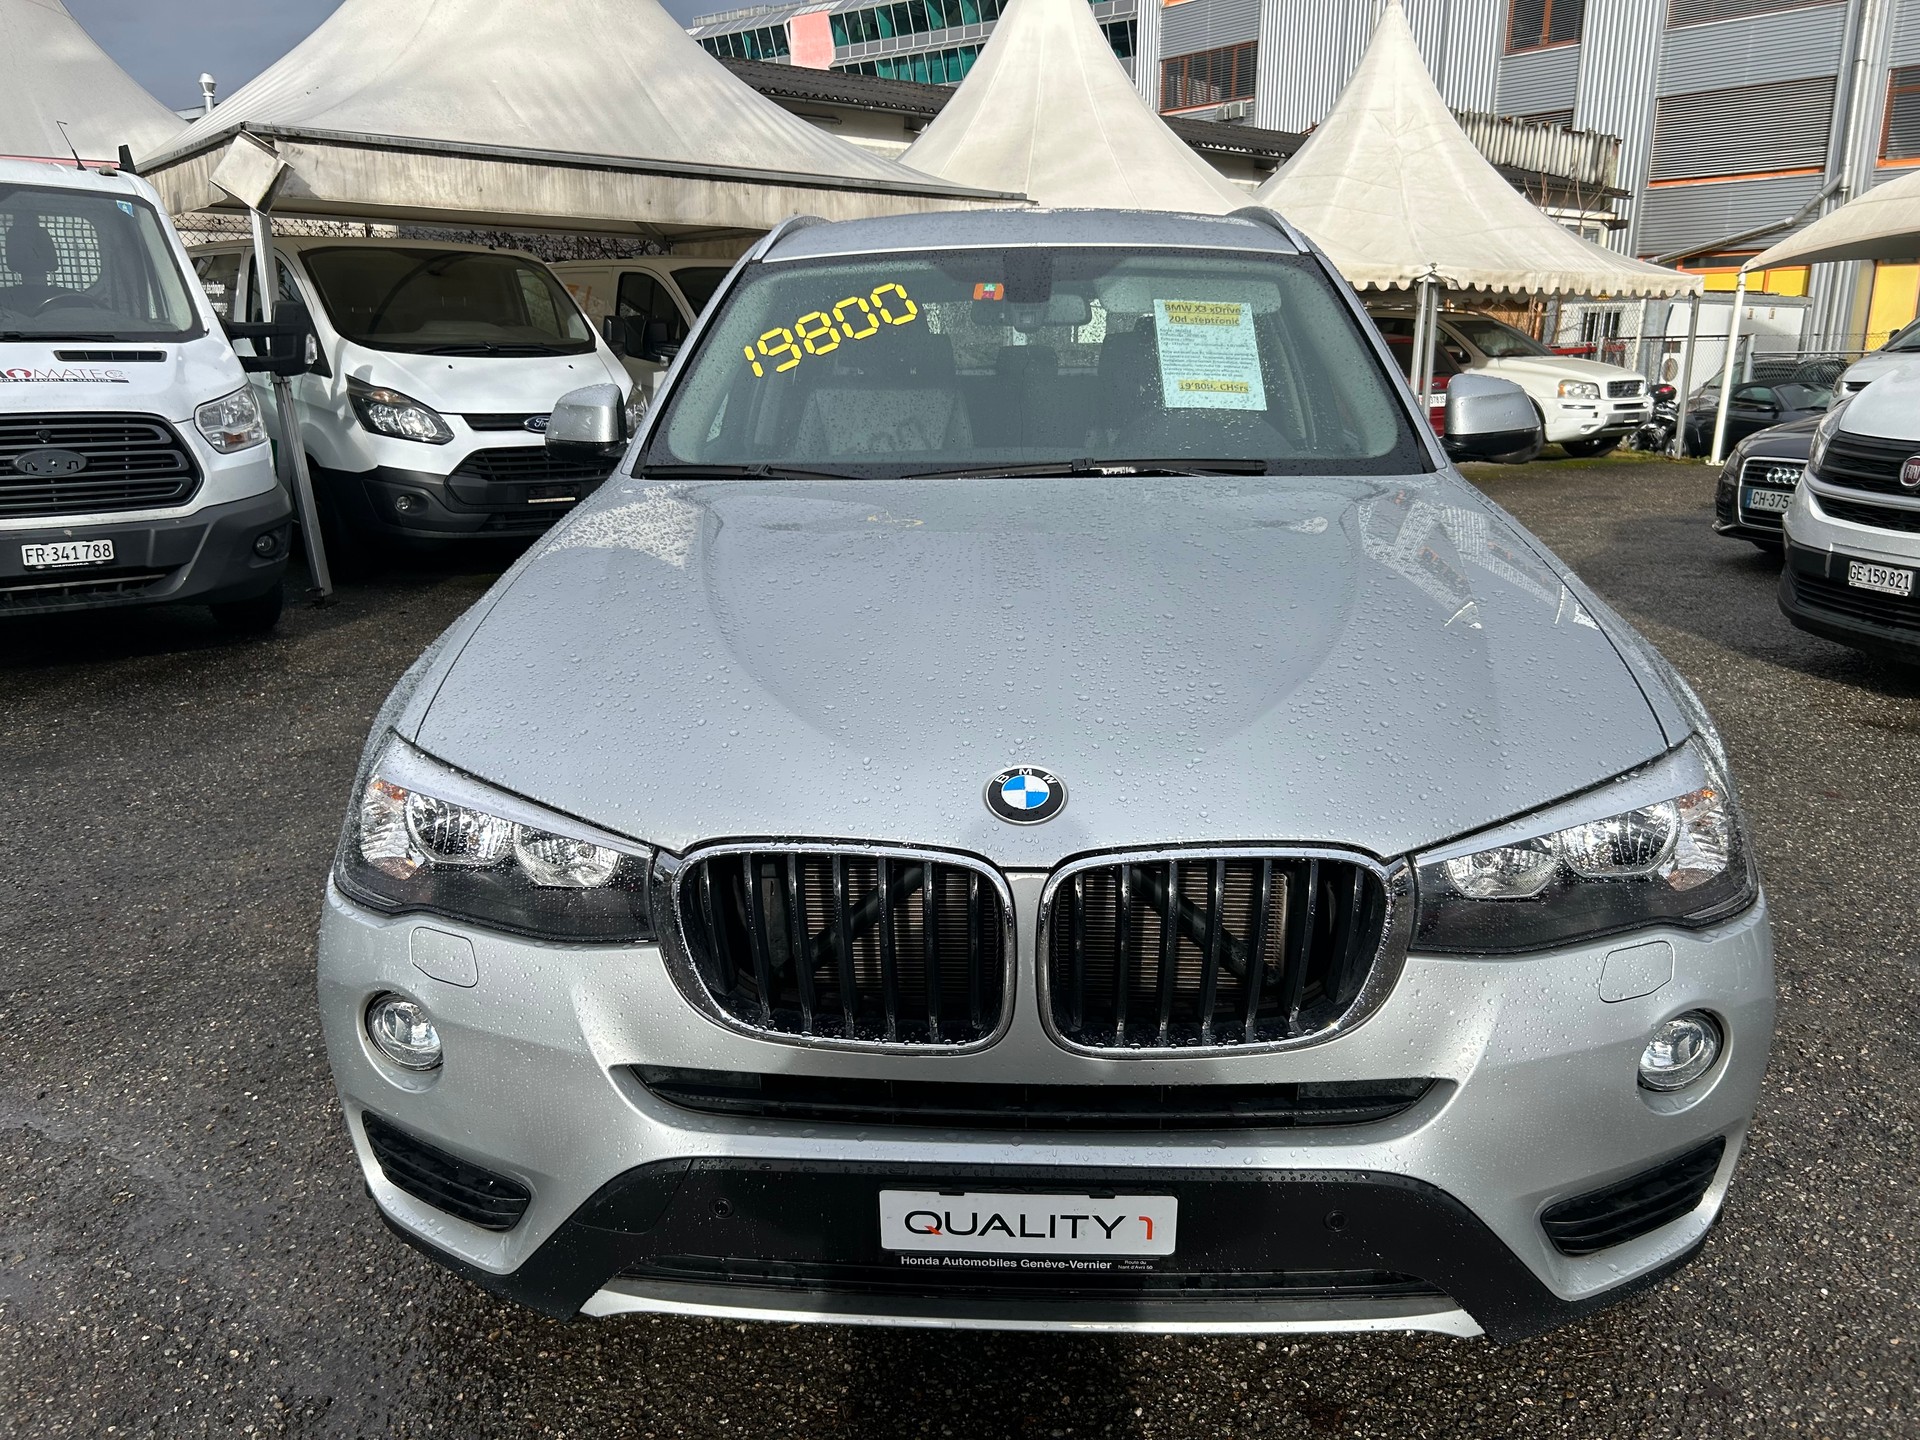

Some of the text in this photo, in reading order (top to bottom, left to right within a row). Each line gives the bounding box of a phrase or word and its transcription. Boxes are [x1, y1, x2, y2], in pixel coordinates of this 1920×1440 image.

[1165, 304, 1241, 314] BMW X3 xDrive
[1169, 315, 1240, 326] 20d steptronic
[744, 283, 918, 378] 19800
[995, 768, 1058, 784] BMW
[904, 1210, 1153, 1240] QUALITY 1
[901, 1256, 1112, 1269] Honda Automobiles Genève-Vernier
